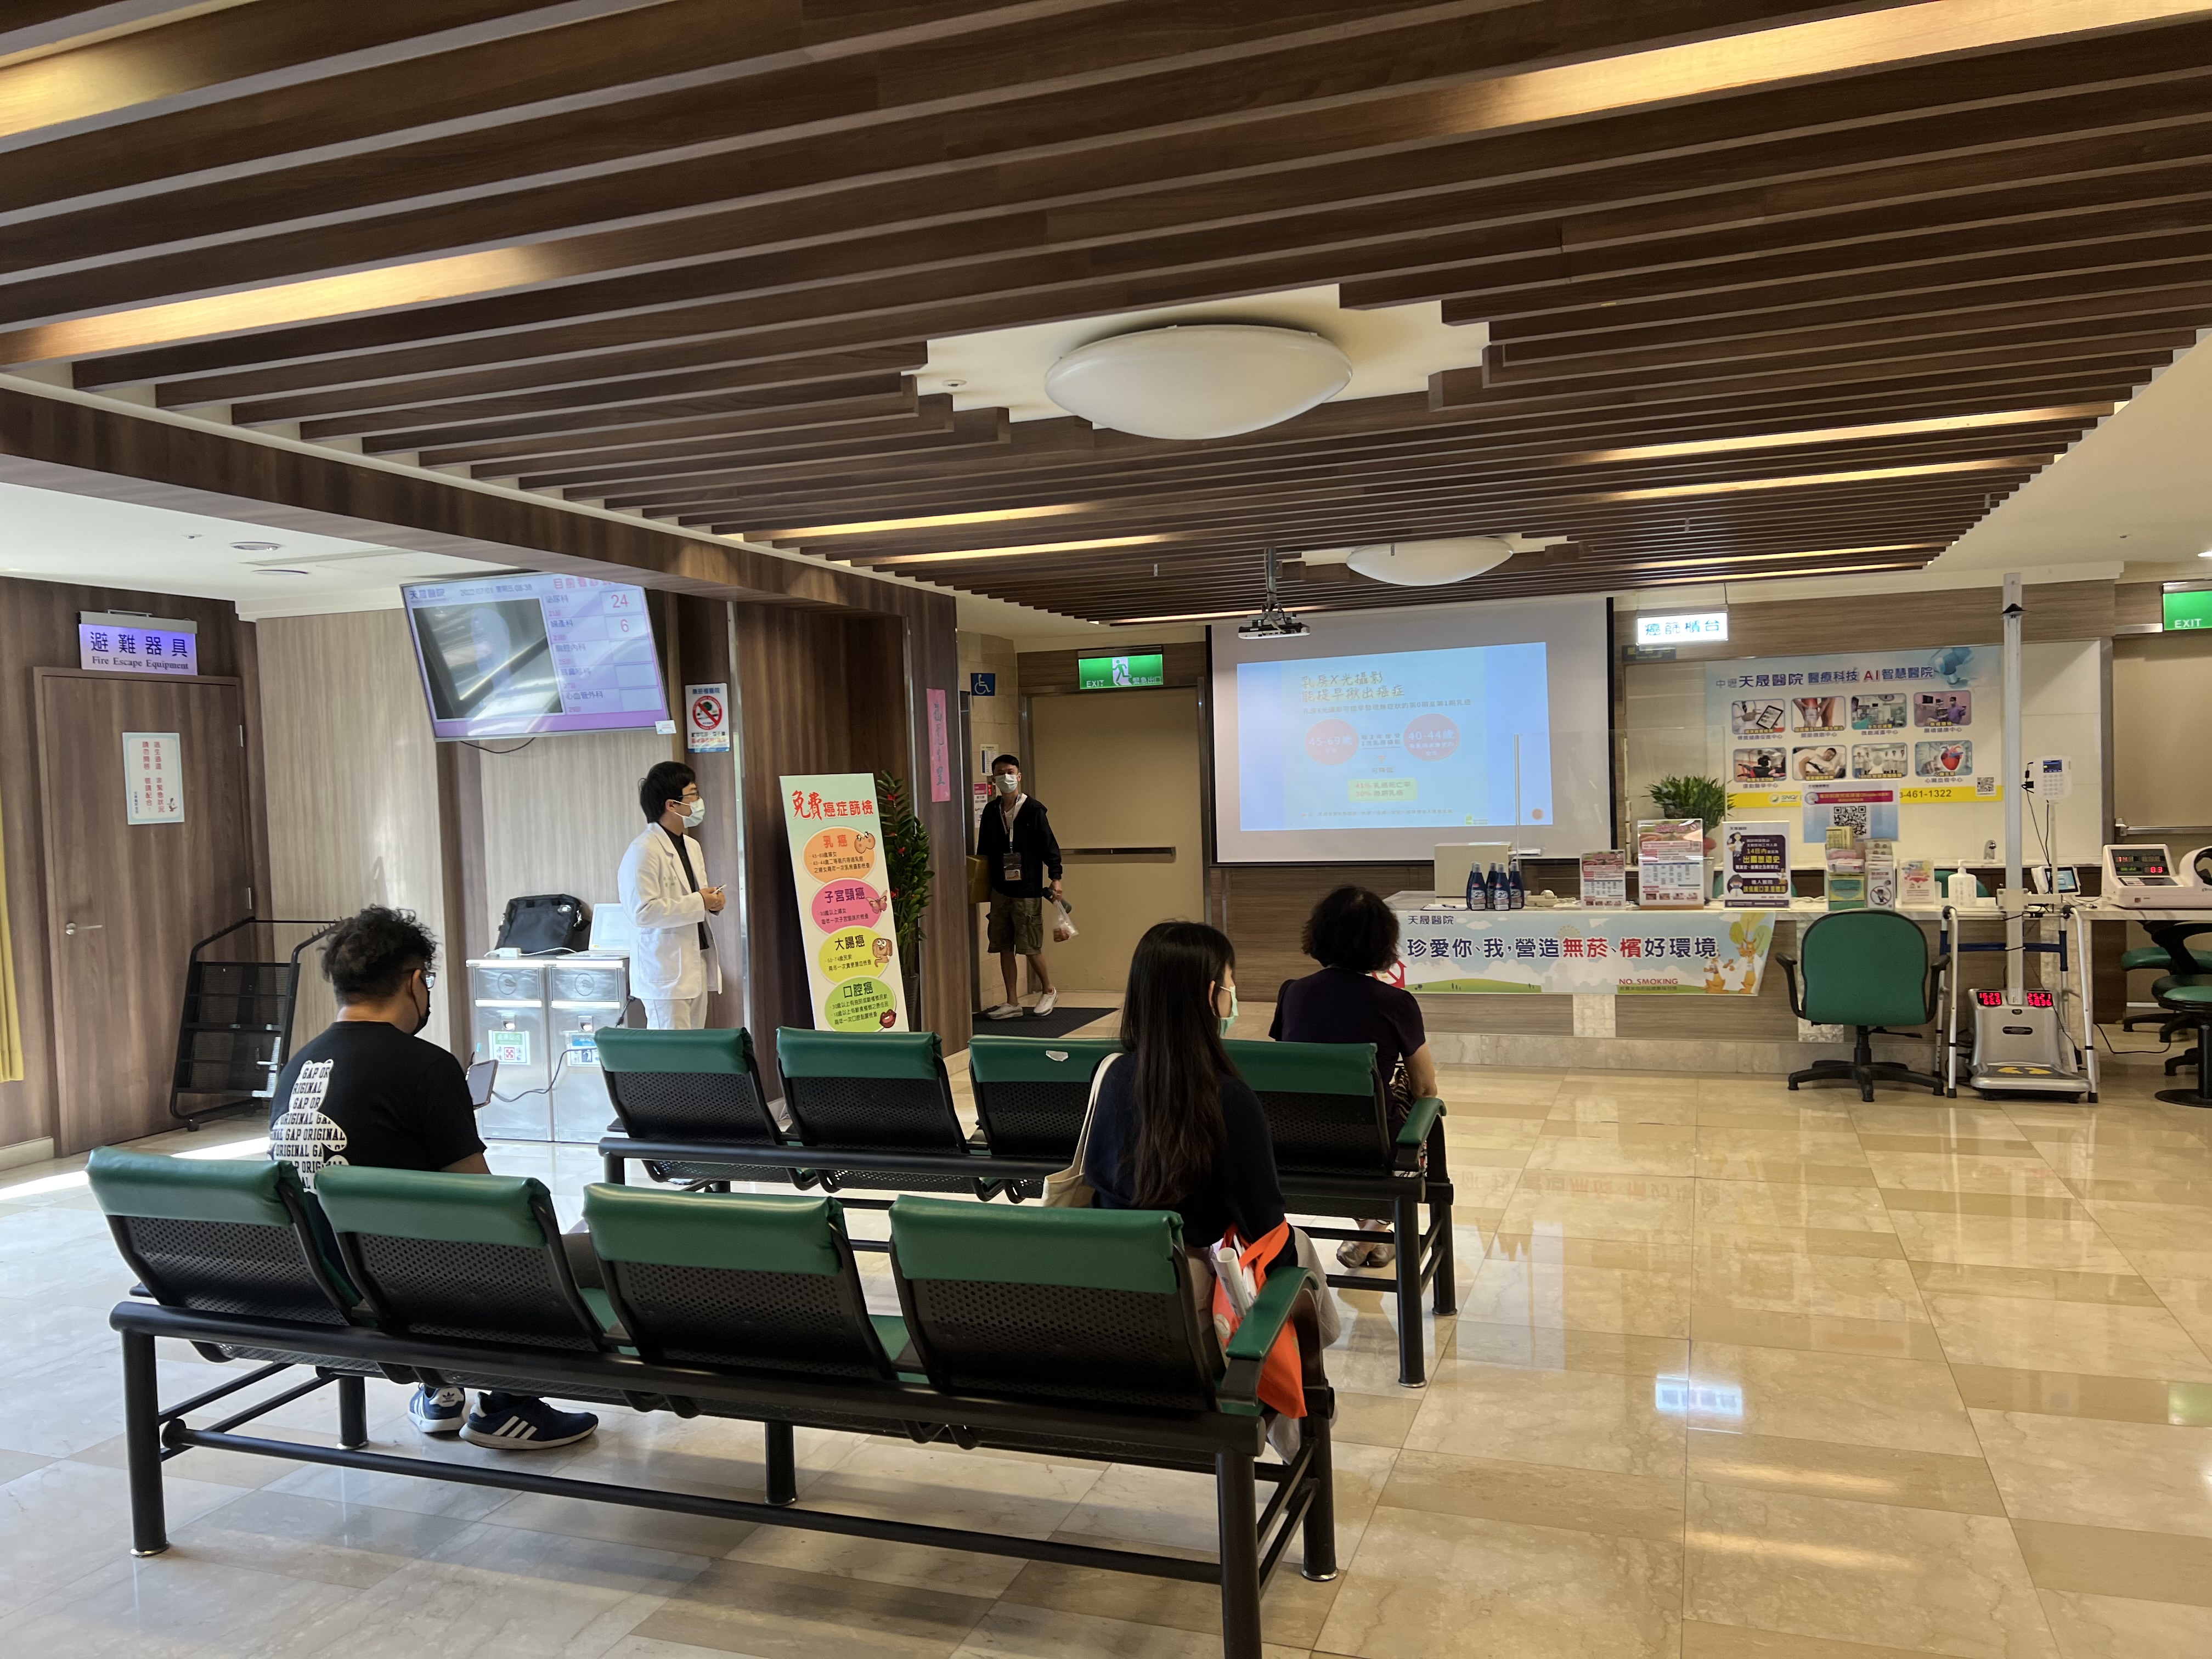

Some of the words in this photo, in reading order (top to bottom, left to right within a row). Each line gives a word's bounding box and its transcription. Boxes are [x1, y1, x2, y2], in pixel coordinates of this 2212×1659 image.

[611, 594, 629, 608] 24
[620, 619, 629, 632] 6
[2174, 618, 2202, 628] EXIT
[89, 631, 188, 657] 避難器具
[92, 656, 109, 665] Fire
[113, 657, 143, 668] Escape
[146, 660, 189, 670] Equipment
[1132, 676, 1162, 685] 緊急出口
[1301, 671, 1383, 688] 乳房X光攝影
[1808, 670, 1859, 684] 醫療科技
[1301, 684, 1405, 702] 能提早揪出癌症
[1308, 736, 1353, 747] 45-69歲
[1408, 729, 1454, 740] 40-44歲
[792, 790, 874, 821] 免費癌症篩檢
[823, 834, 848, 849] 乳癌
[825, 887, 865, 903] 子宮頸癌
[1408, 915, 1454, 925] 天晟醫院
[834, 935, 865, 951] 大腸癌
[843, 981, 873, 998] 口腔癌
[302, 1067, 317, 1079] GAP
[293, 1097, 309, 1109] GAP
[280, 1112, 313, 1125] ORIGINAL
[285, 1128, 301, 1141] GAP
[303, 1128, 346, 1141] ORIGINAL
[276, 1144, 309, 1158] ORIGINAL
